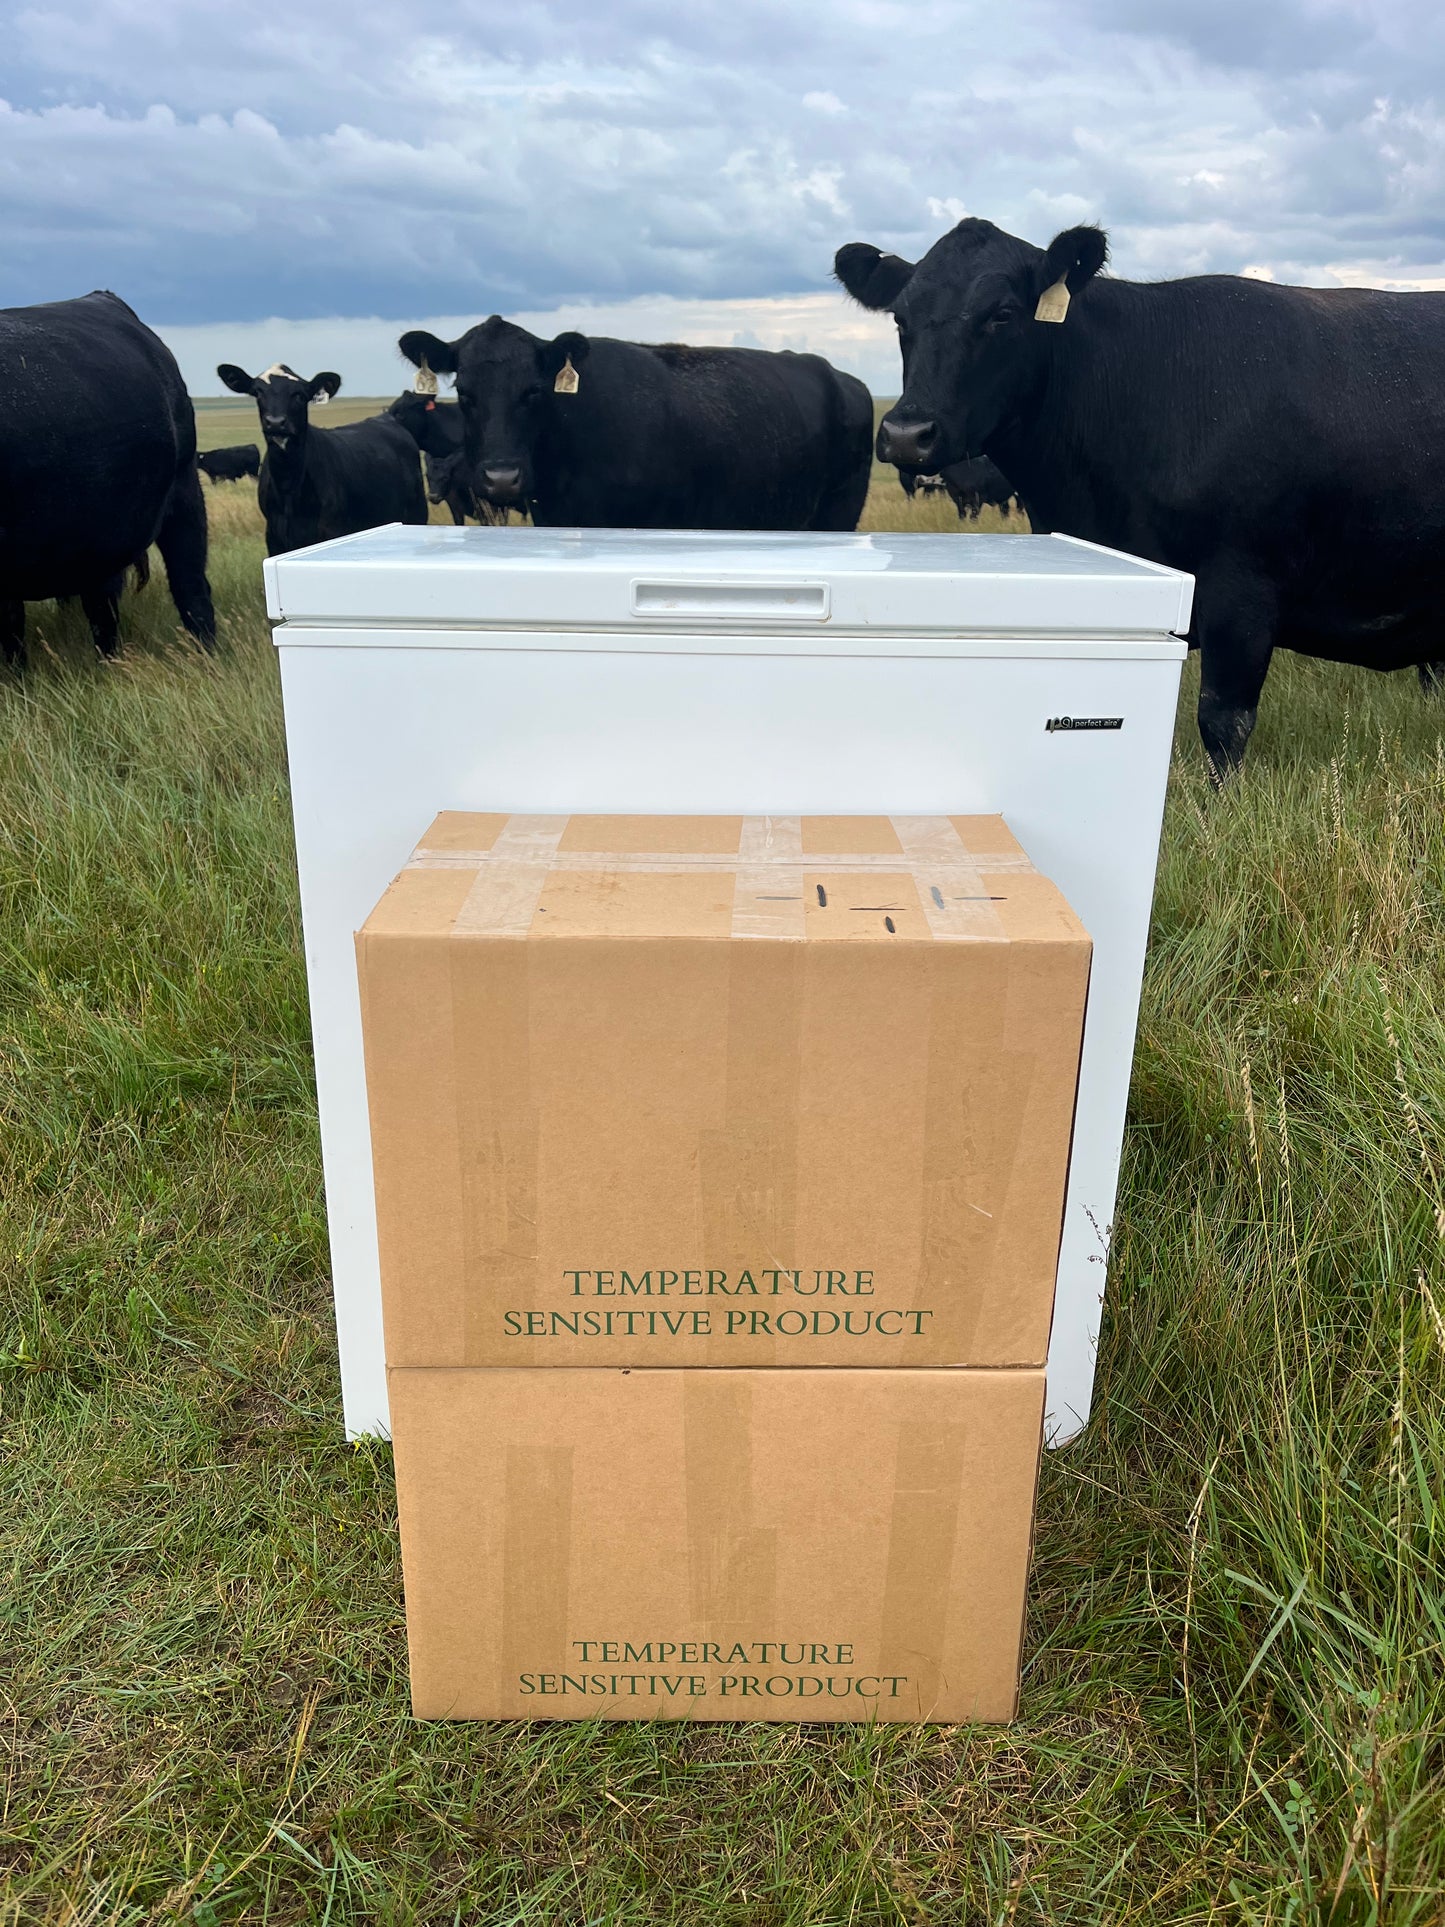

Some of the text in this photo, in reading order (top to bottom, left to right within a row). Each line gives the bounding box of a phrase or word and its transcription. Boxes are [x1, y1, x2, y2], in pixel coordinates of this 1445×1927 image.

[1074, 720, 1102, 728] perfect
[563, 1269, 875, 1296] TEMPERATURE
[503, 1310, 933, 1336] SENSITIVE PRODUCT
[573, 1641, 854, 1665] TEMPERATURE
[519, 1673, 908, 1698] SENSITIVE PRODUCT
